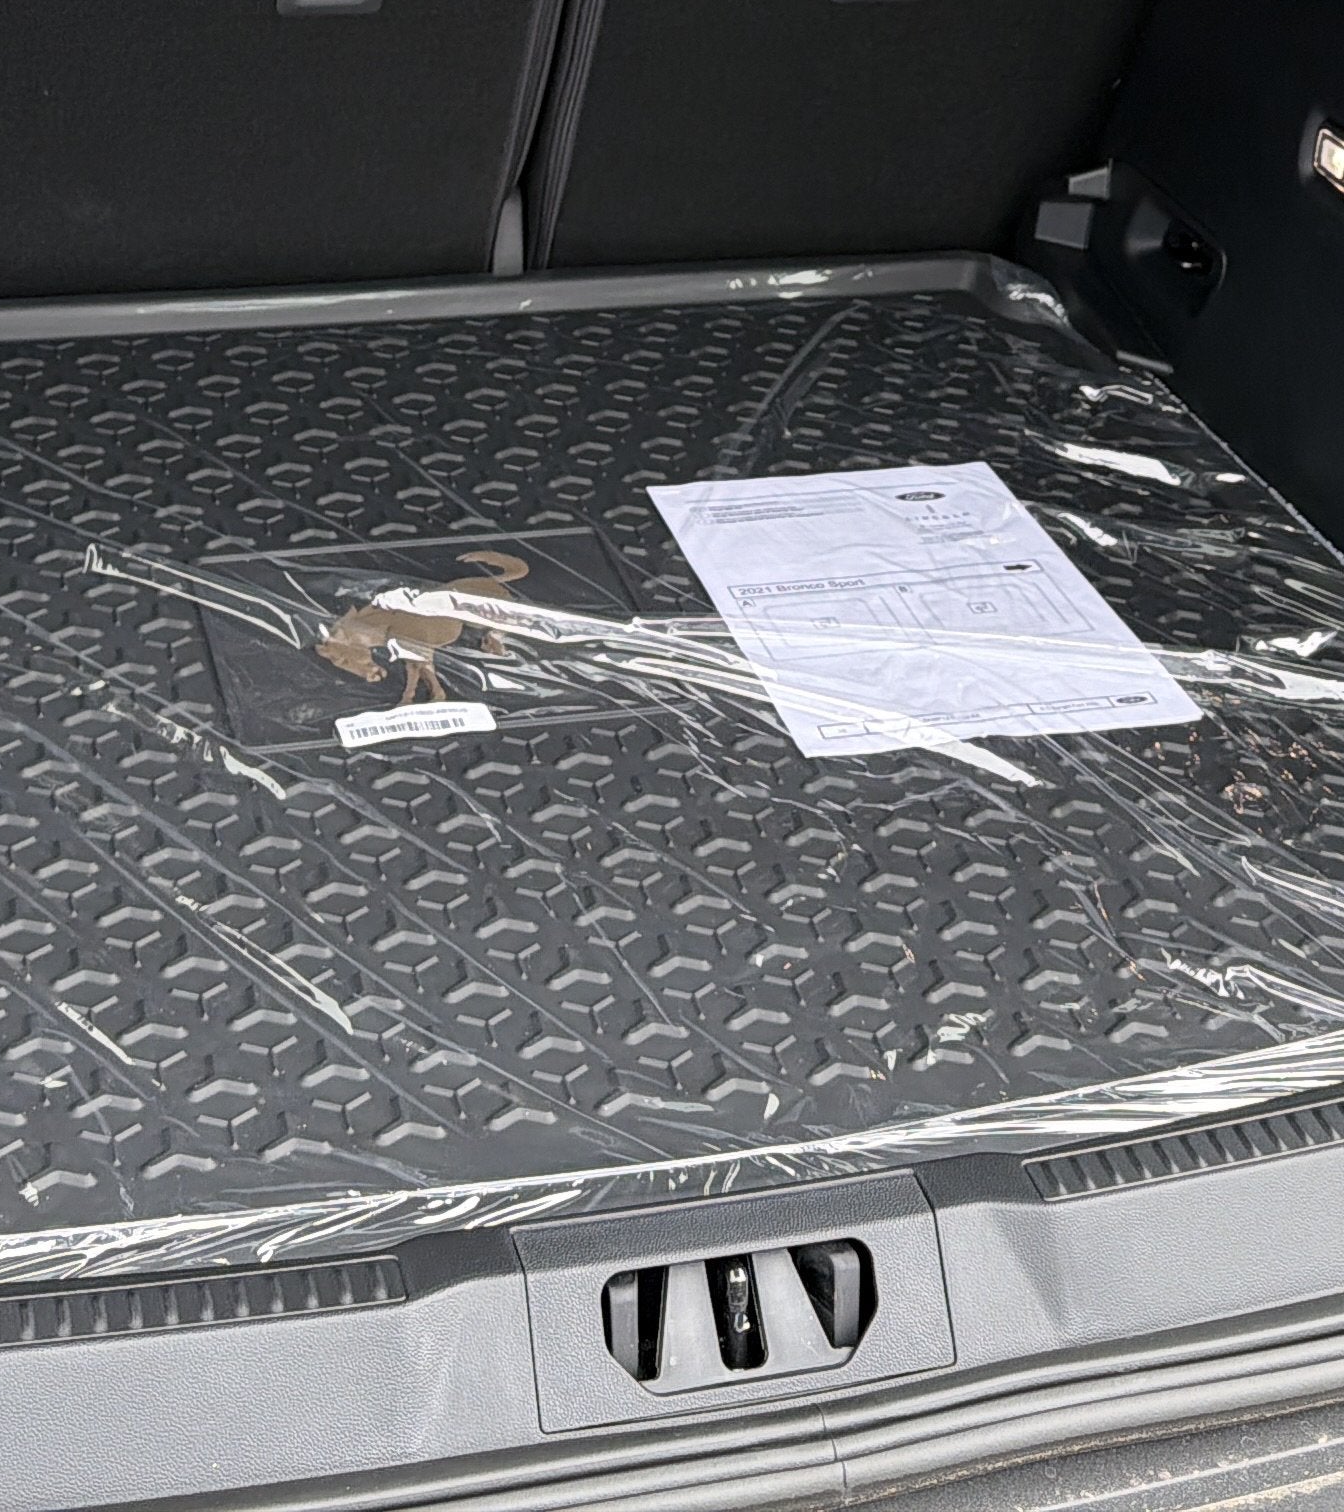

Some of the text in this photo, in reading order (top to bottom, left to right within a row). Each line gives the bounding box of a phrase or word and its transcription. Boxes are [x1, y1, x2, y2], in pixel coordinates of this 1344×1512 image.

[738, 578, 866, 596] 2021 Bronco Sport
